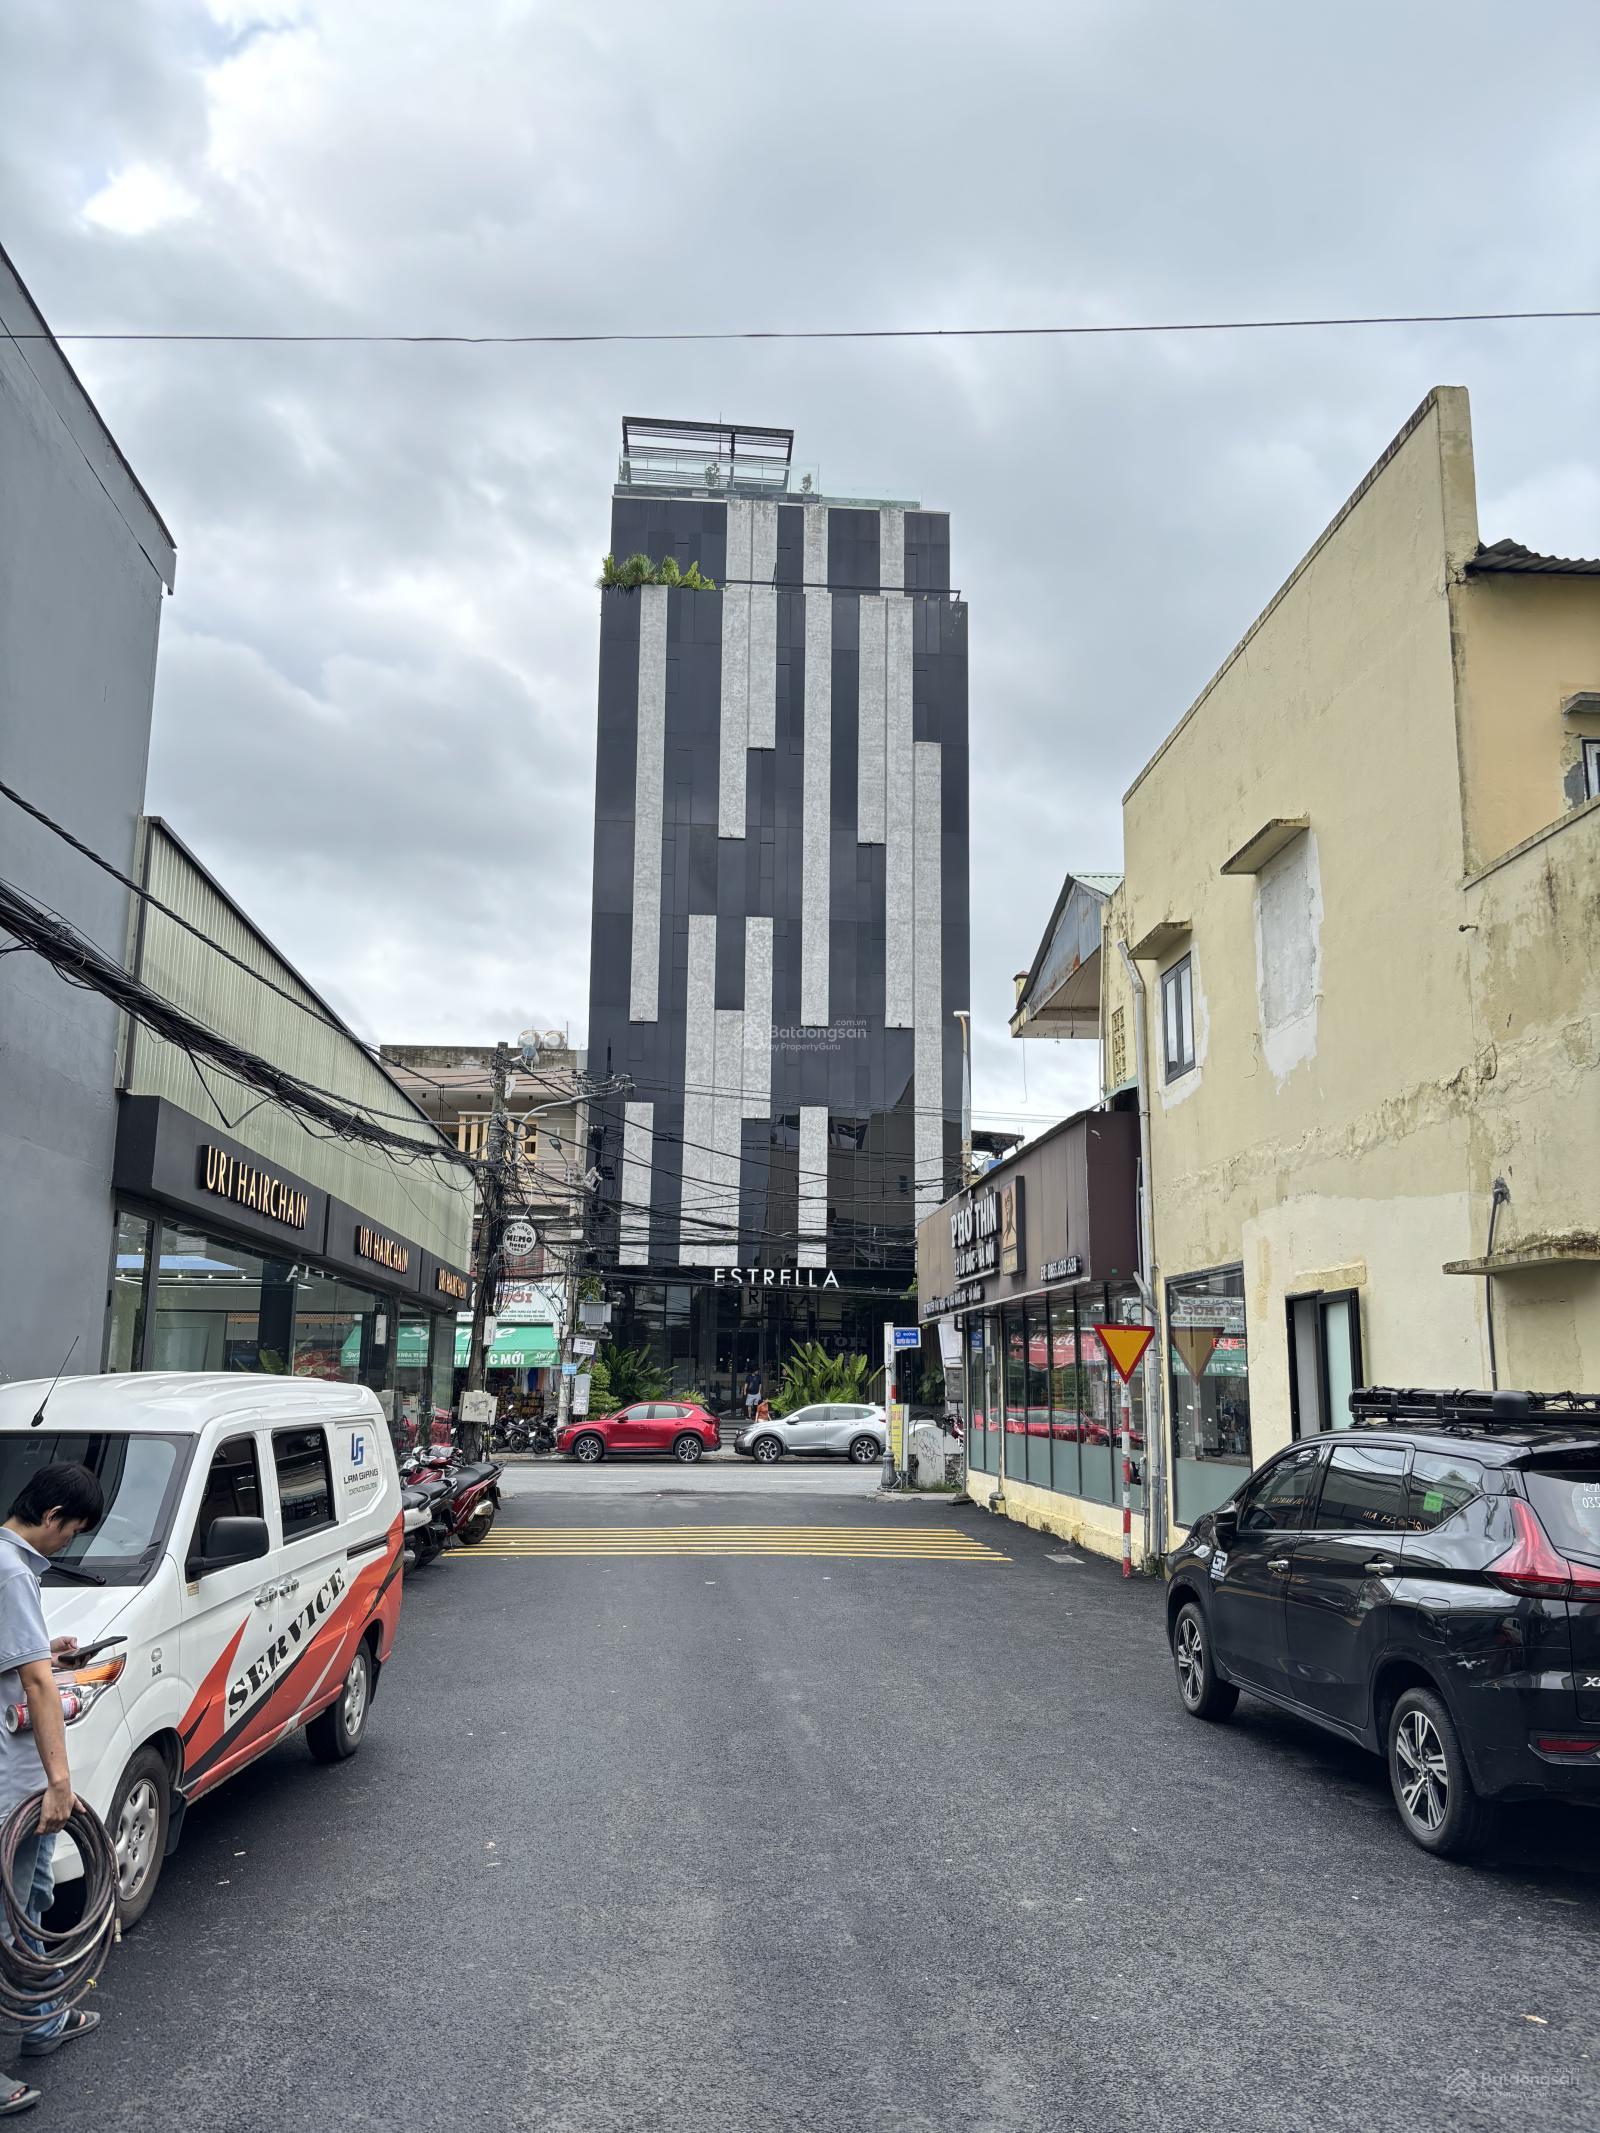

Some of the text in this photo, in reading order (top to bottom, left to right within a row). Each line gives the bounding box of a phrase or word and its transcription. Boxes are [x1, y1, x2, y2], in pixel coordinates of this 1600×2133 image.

[206, 1145, 308, 1229] URI HAIRCHAIN
[951, 1187, 996, 1248] PHỞ THÌN
[360, 1226, 409, 1273] URI HAIRCHAIN
[713, 1267, 840, 1289] ESTRELLA
[500, 1351, 525, 1365] MỚI
[344, 1468, 379, 1485] LAM GIANG
[228, 1567, 346, 1718] SERVICE
